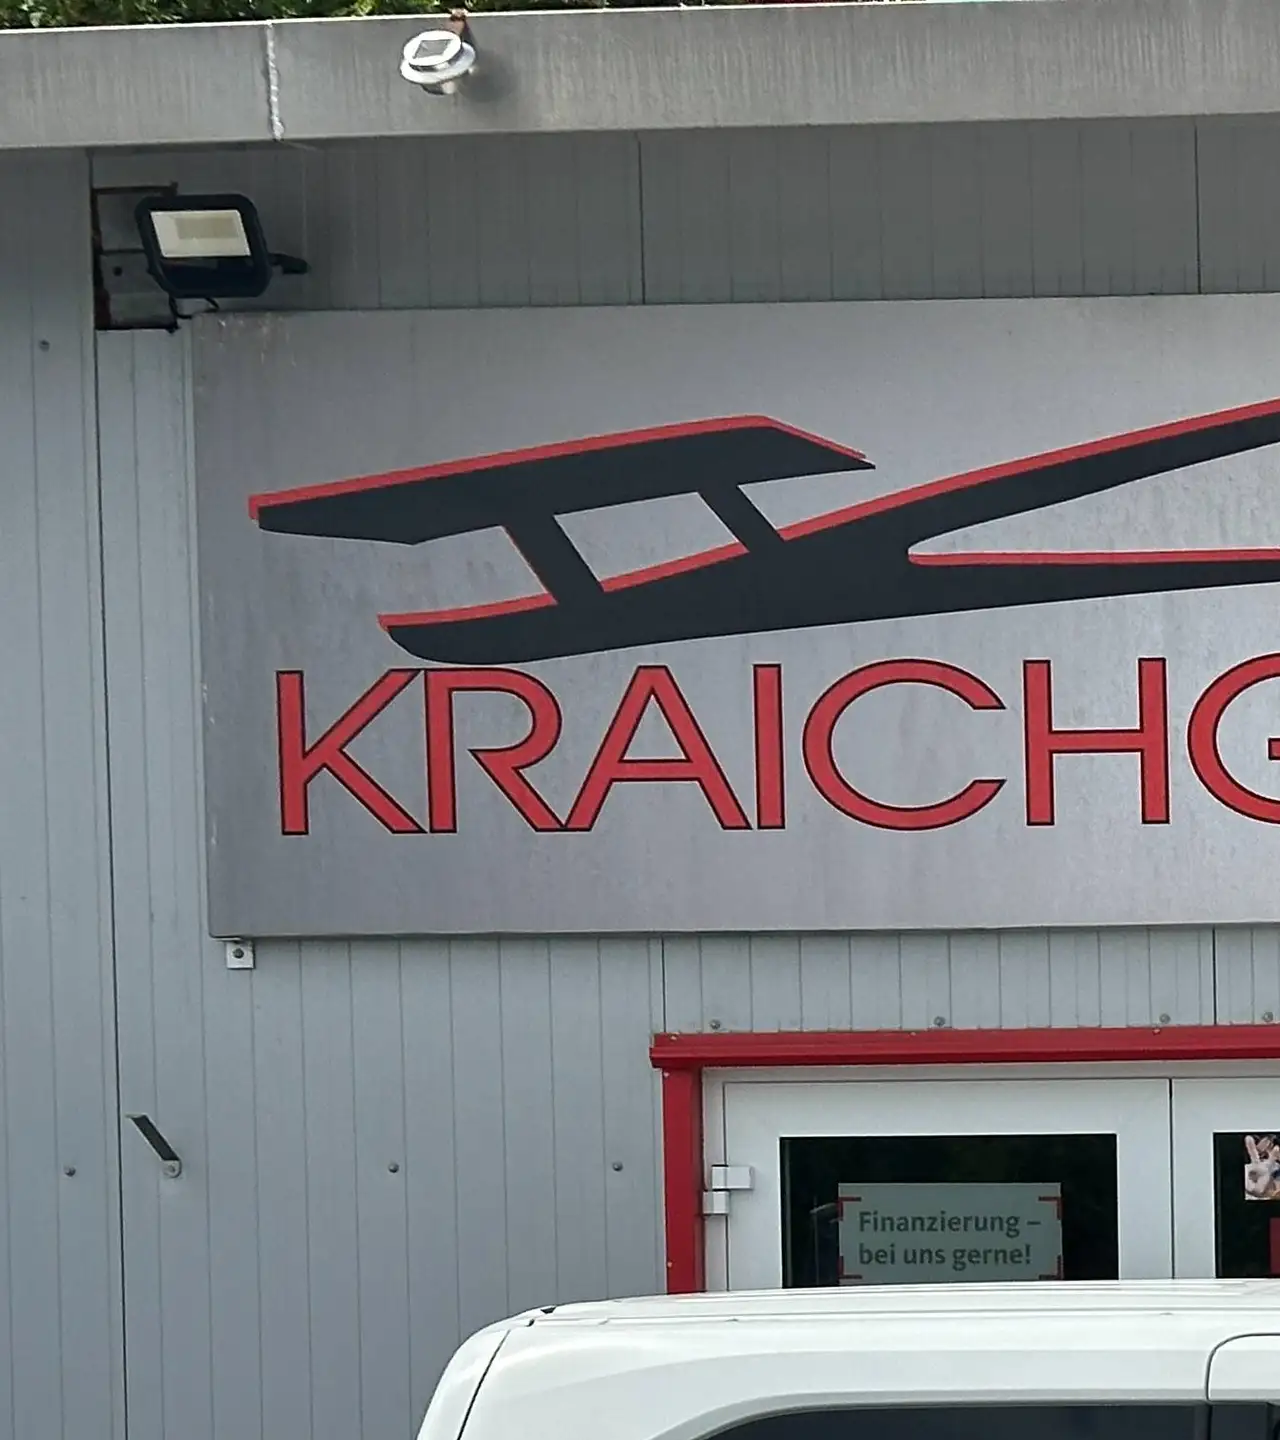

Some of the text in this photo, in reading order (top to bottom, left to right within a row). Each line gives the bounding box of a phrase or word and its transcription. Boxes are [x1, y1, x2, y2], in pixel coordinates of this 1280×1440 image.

[858, 1210, 1020, 1238] Finanzierung
[858, 1243, 1032, 1272] bei uns gerne!
